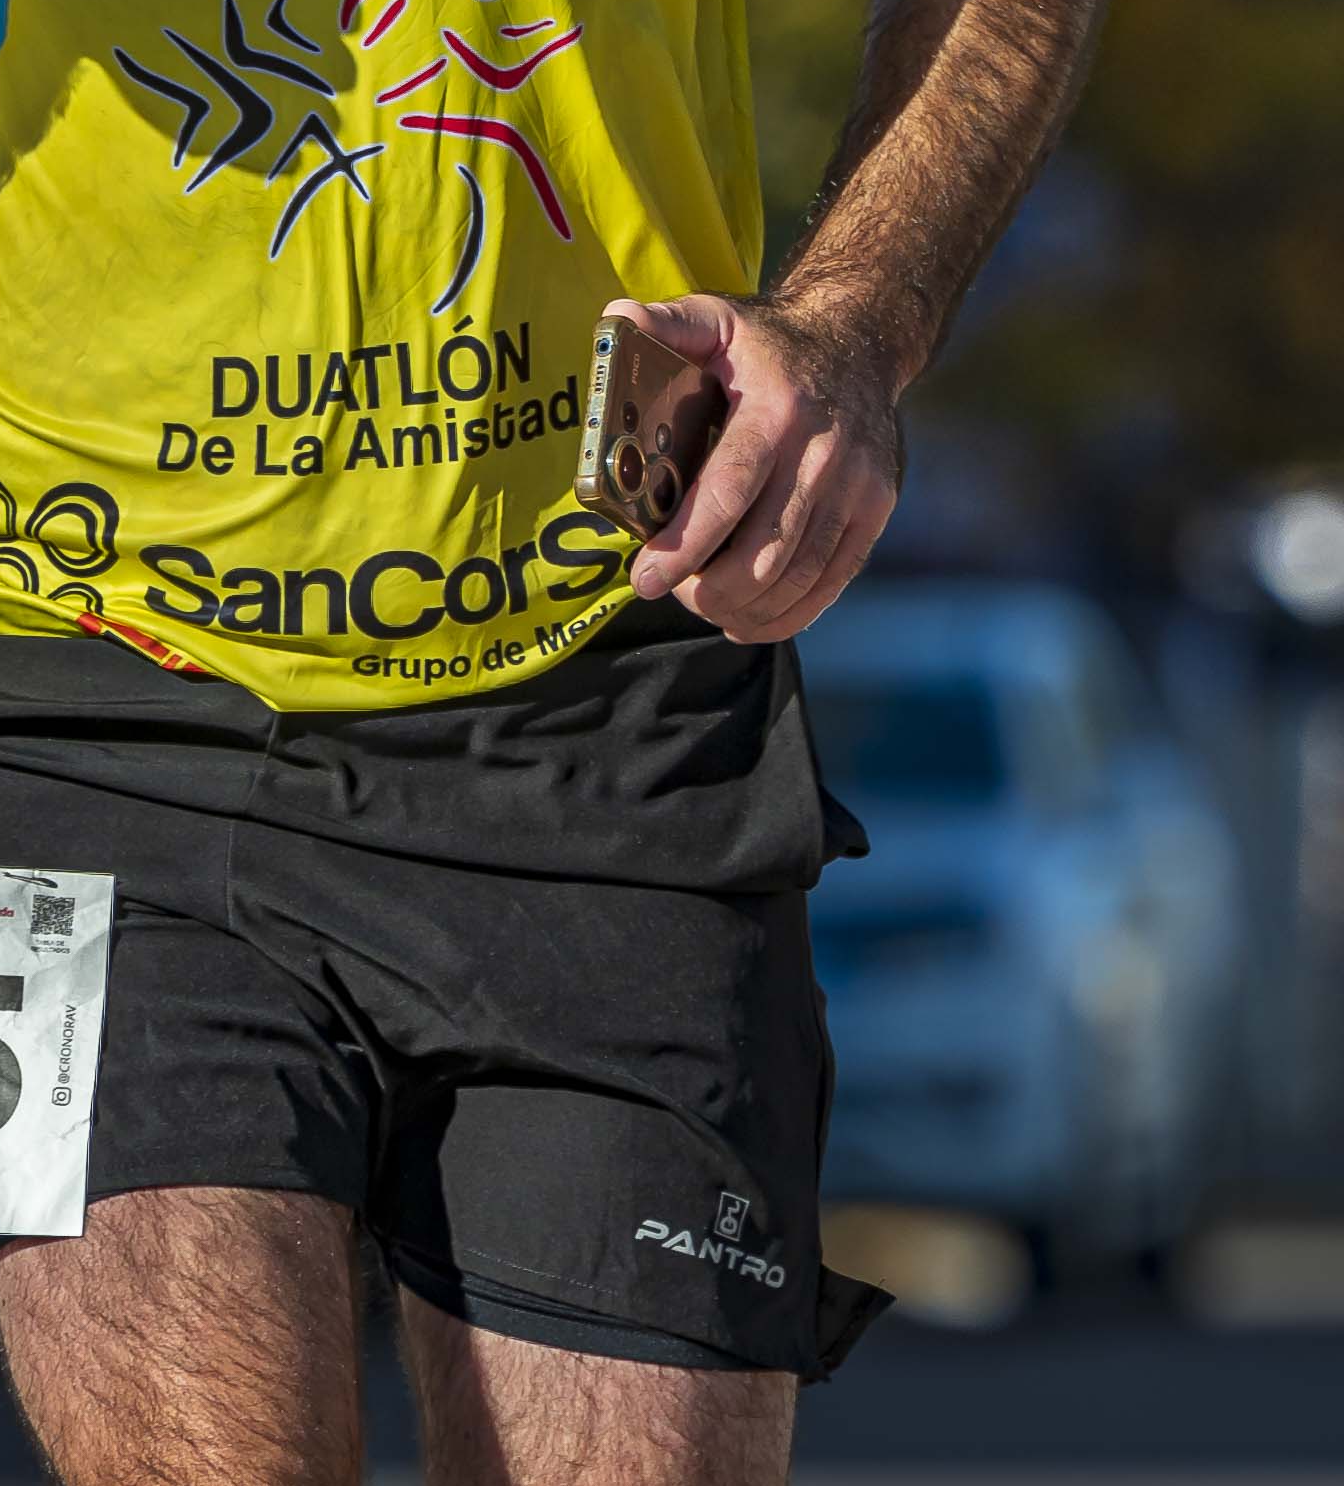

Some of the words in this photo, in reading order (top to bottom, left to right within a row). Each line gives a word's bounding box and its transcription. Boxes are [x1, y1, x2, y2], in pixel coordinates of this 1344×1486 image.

[211, 314, 531, 418] DUATLÓN
[157, 422, 235, 476] De
[254, 424, 324, 477] La
[344, 375, 580, 471] Amistad
[138, 510, 640, 640] SanCorS
[352, 652, 472, 686] Grupo
[482, 639, 526, 672] de
[57, 1004, 77, 1084] @CRONORAV
[634, 1219, 786, 1289] PANTRO
